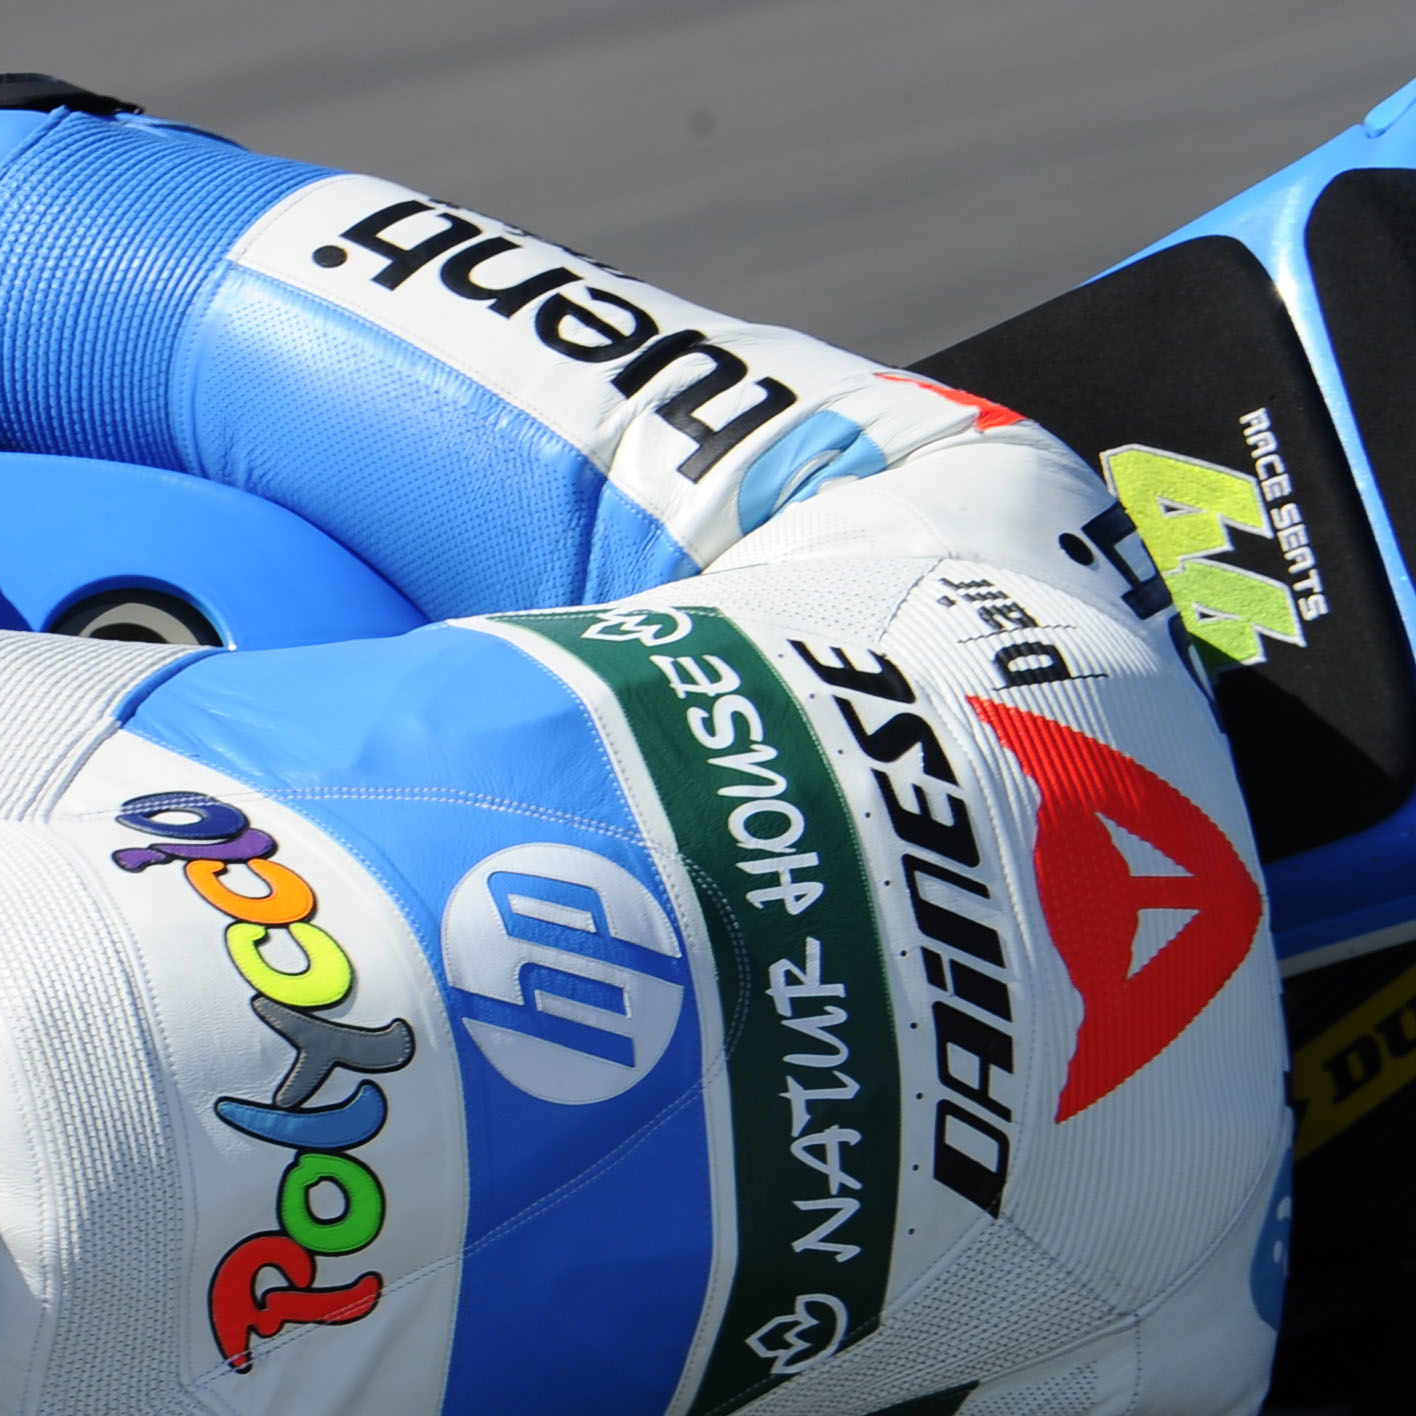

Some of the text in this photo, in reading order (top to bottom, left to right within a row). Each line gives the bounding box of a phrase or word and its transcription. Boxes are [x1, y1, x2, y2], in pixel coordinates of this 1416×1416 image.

[312, 199, 798, 484] tuenti
[1239, 407, 1331, 621] RACE SEATS
[441, 842, 684, 1106] hp
[651, 652, 865, 1263] NATUR HOUSE
[788, 638, 1016, 1221] DAINESE
